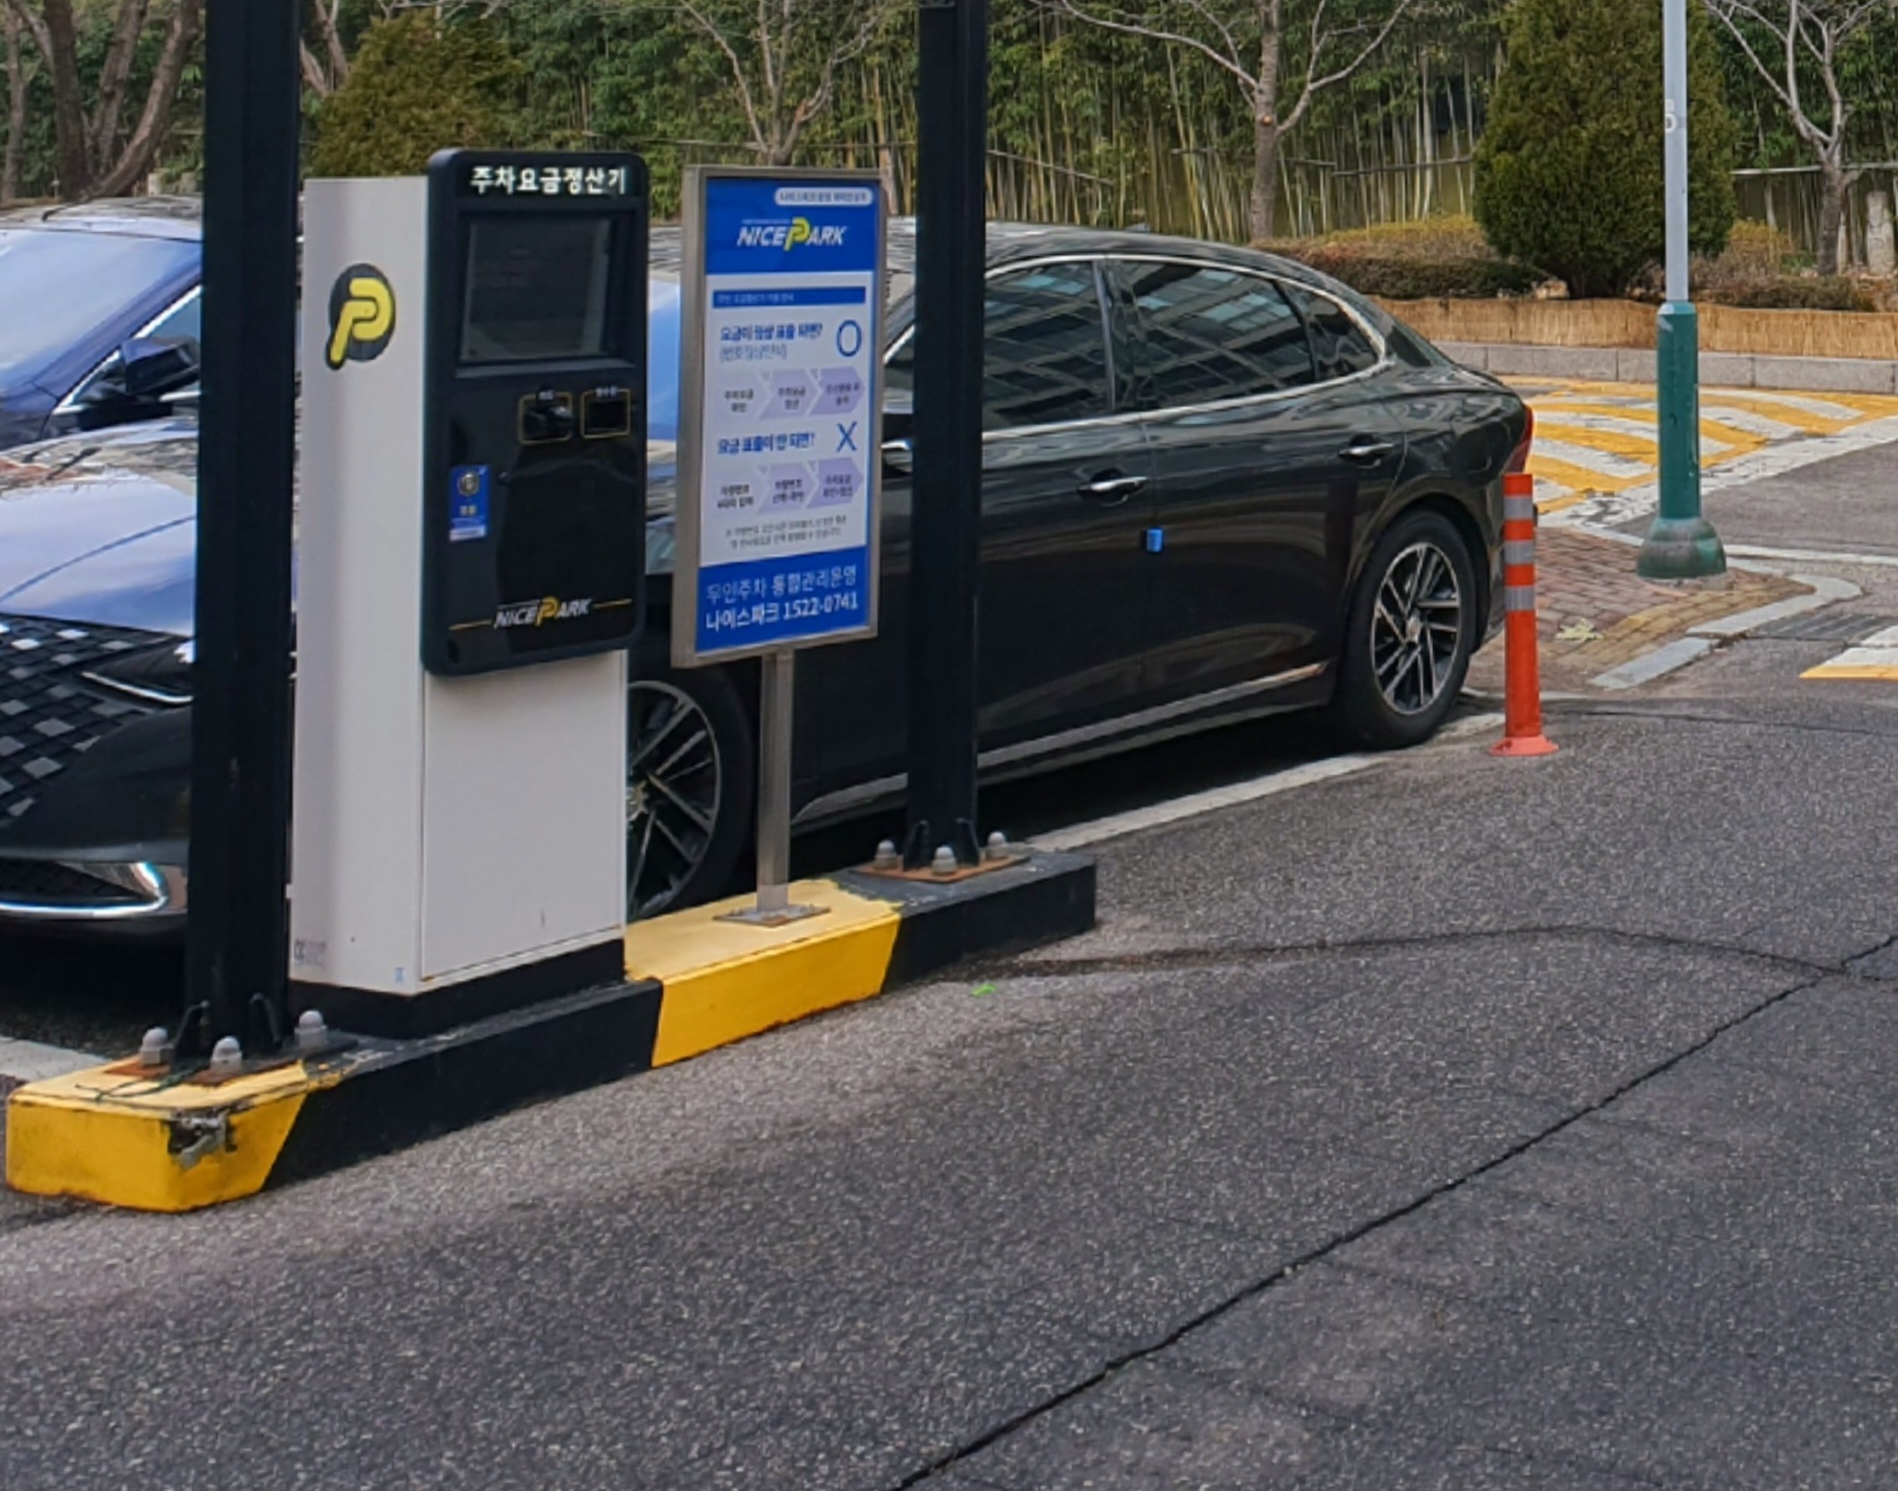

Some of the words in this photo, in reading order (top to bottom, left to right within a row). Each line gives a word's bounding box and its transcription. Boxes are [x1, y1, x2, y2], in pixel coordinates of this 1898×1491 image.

[470, 165, 626, 196] 주차요금정산기
[706, 576, 767, 604] 무인주차
[772, 563, 857, 597] 통합관리운영
[705, 602, 780, 632] 나이스파크
[783, 590, 859, 621] 1522-0741
